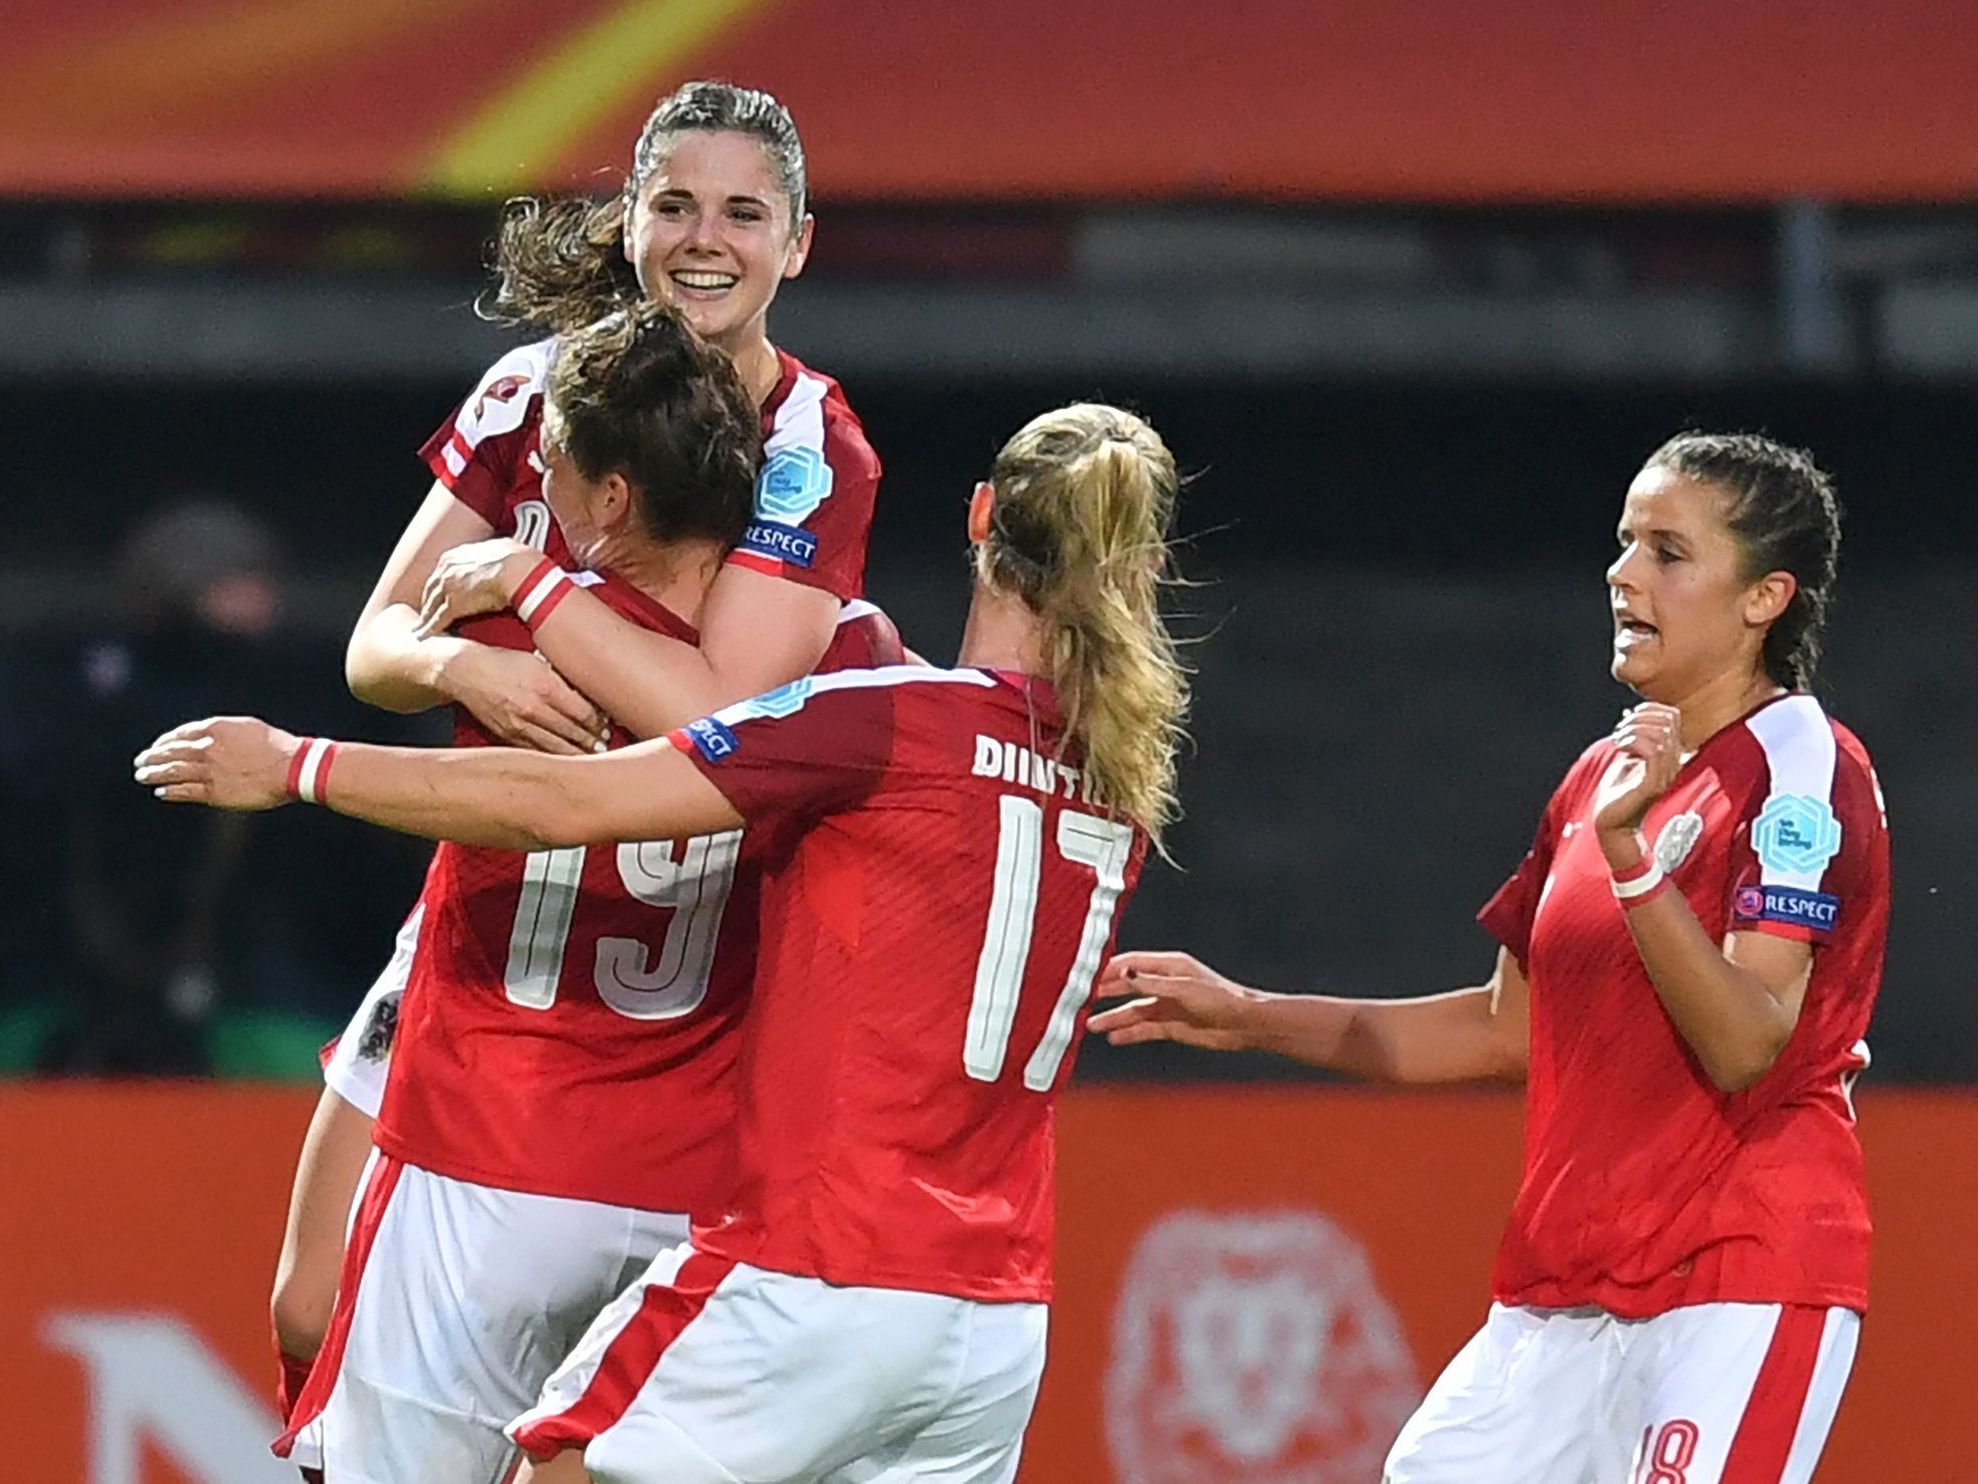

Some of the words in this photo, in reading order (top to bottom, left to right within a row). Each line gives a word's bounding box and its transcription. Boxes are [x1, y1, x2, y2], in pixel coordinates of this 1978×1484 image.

[504, 828, 744, 1020] 19
[964, 795, 1133, 1092] 17
[1766, 895, 1837, 921] RESPECT
